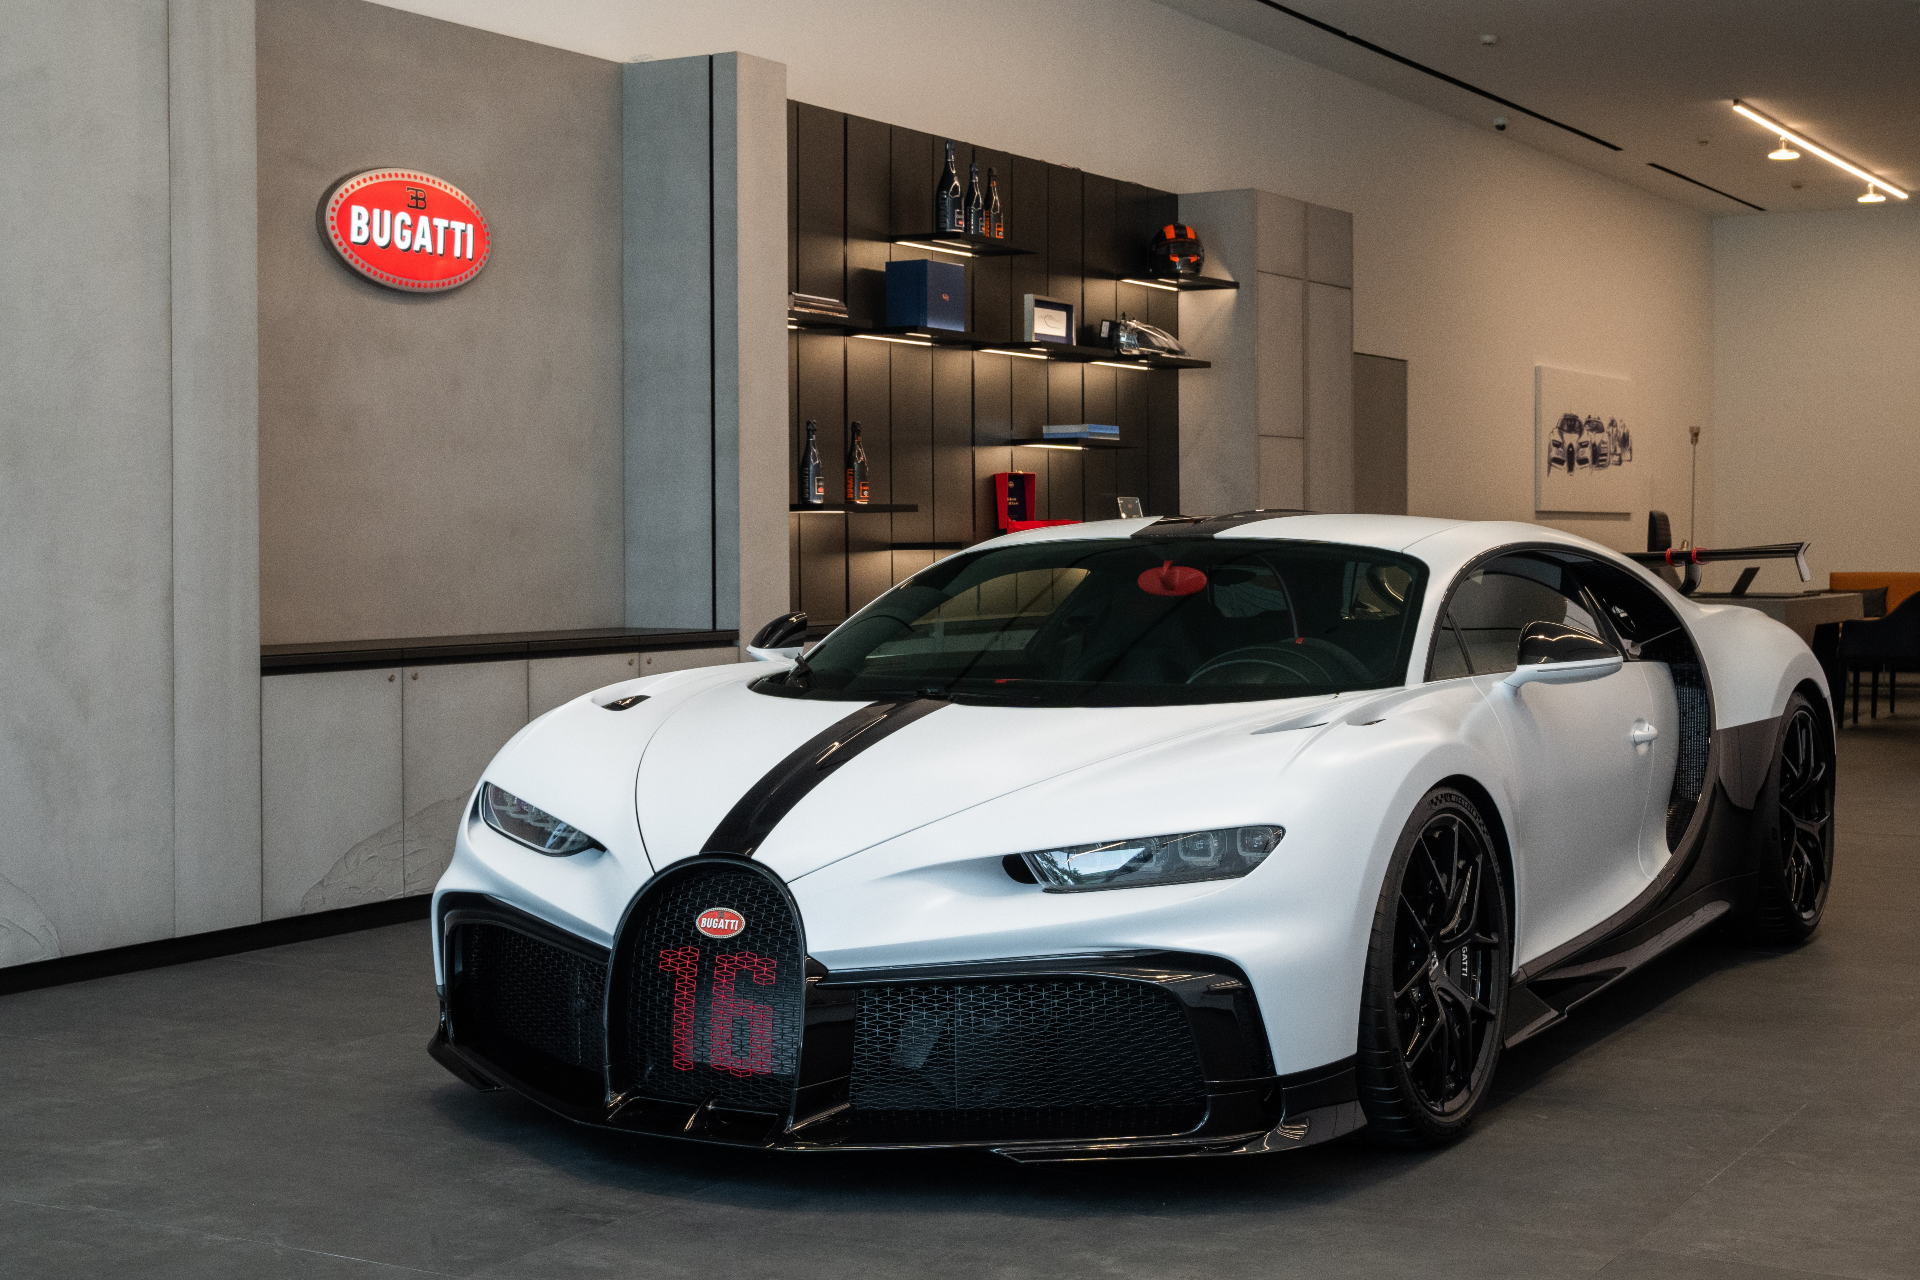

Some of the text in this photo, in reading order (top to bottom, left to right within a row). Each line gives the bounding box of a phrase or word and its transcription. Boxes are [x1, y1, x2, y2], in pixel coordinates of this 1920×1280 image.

[350, 205, 474, 261] BUGATTI
[1451, 795, 1477, 817] MICHELIN
[701, 918, 739, 931] BUGATTI
[659, 946, 777, 1078] 16
